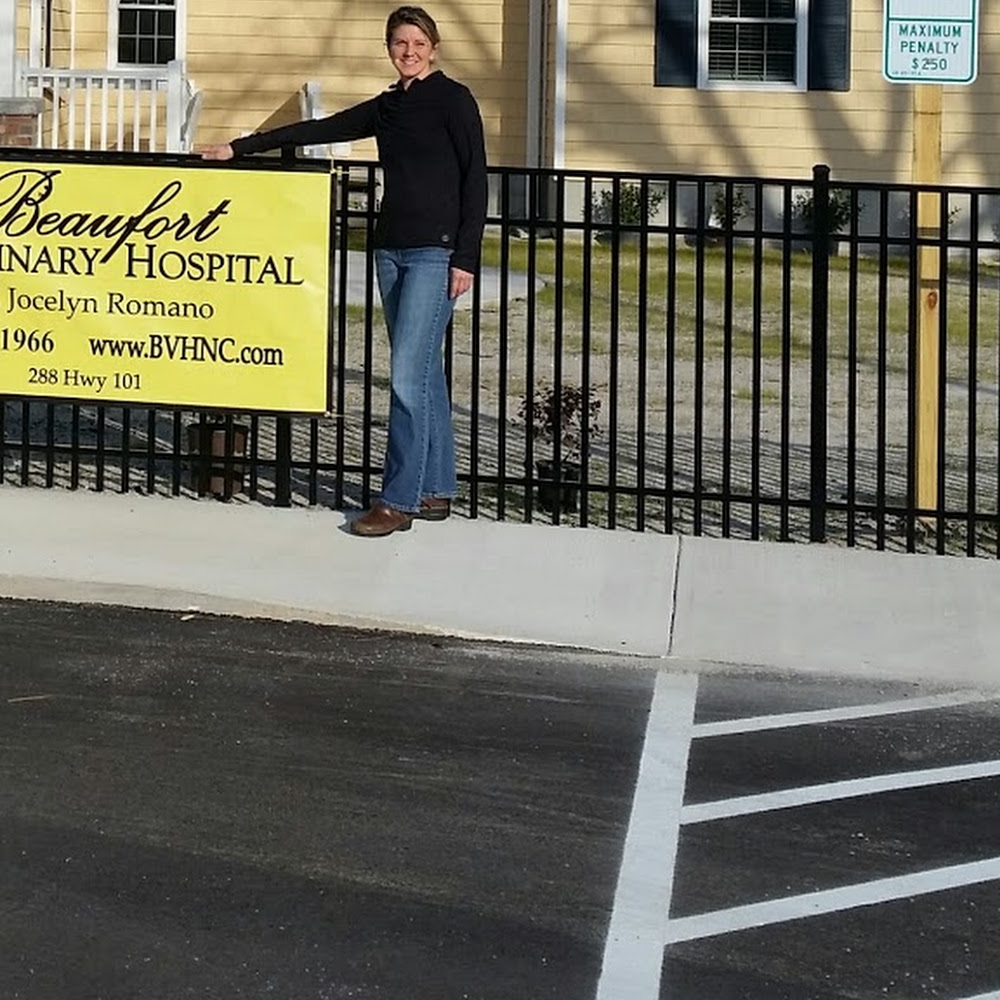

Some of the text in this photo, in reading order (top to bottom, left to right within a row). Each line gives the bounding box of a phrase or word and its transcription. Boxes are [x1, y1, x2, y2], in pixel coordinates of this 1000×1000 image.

[899, 25, 962, 37] MAXIMUM
[900, 41, 958, 54] PENALTY
[124, 242, 304, 286] HOSPITAL
[7, 287, 99, 315] Jocelyn
[107, 292, 215, 320] Romano
[89, 334, 284, 366] www.BVHNC.com
[28, 368, 142, 392] 288 Hwy 101
